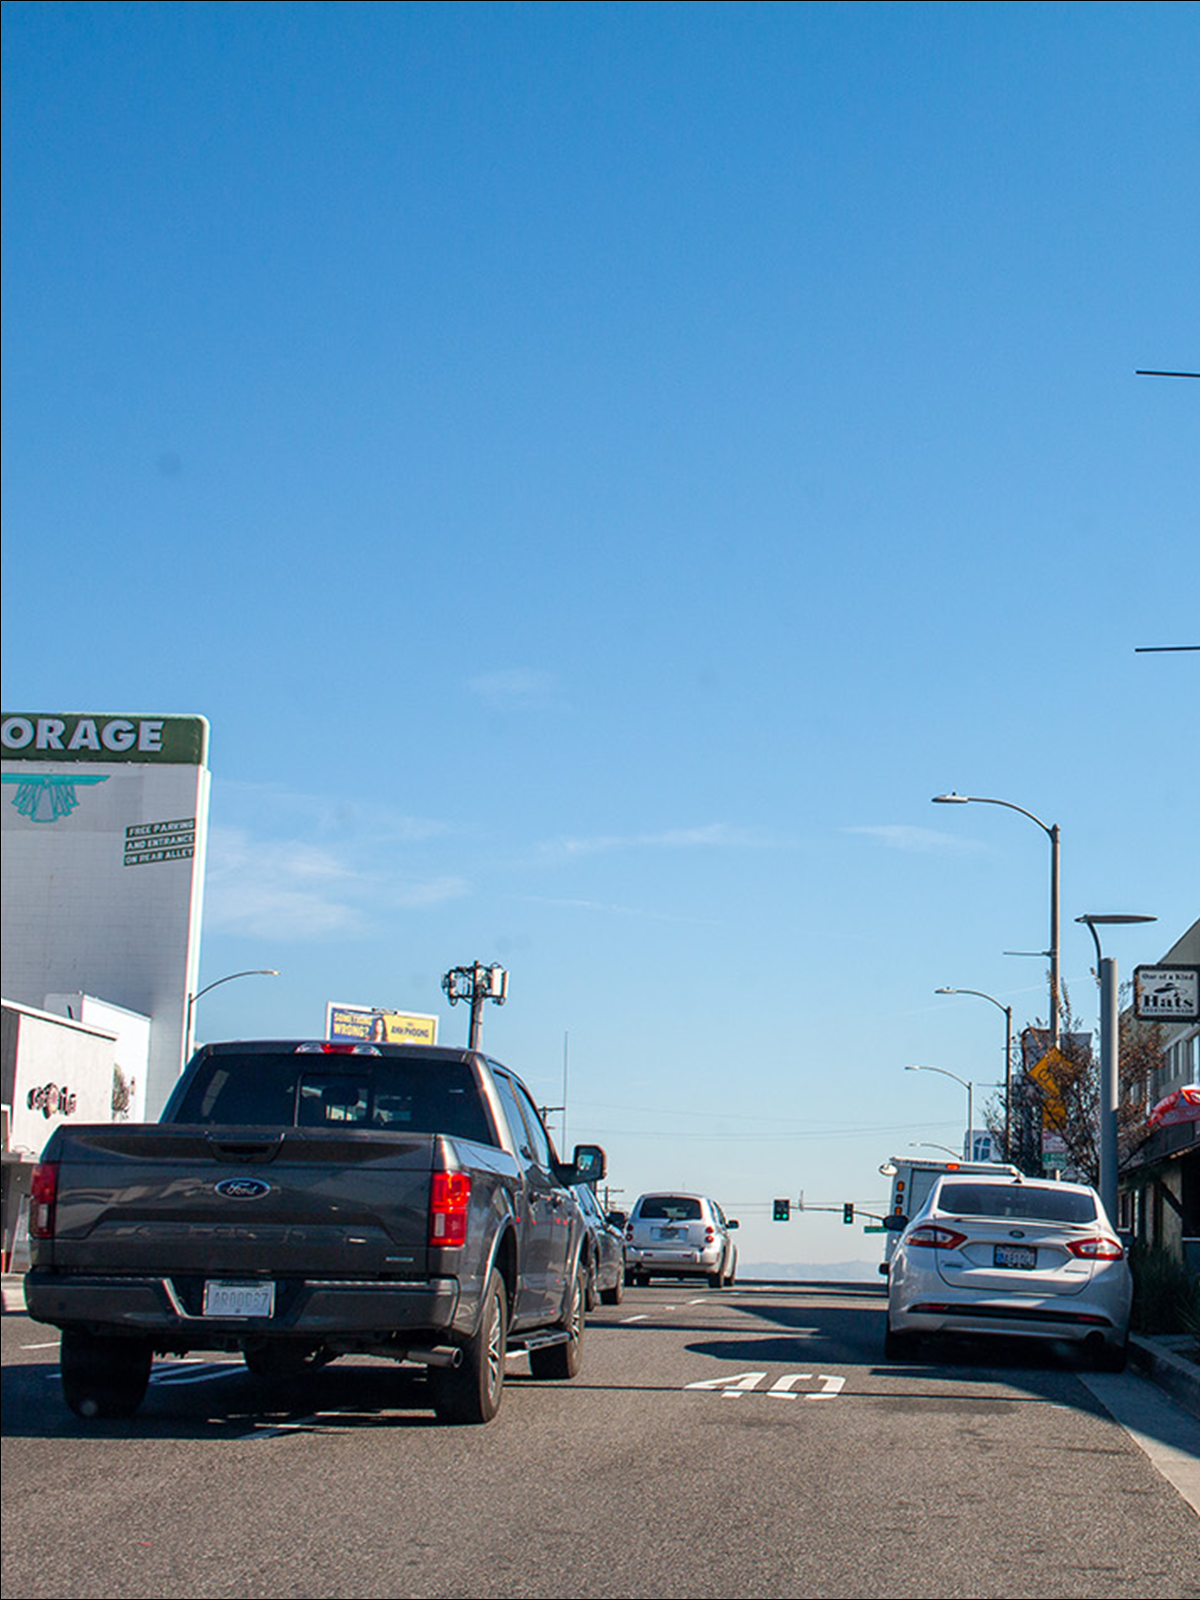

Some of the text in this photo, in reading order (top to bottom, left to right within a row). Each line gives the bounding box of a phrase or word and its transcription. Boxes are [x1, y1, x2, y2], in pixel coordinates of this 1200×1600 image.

[1, 717, 165, 751] ORAGE
[129, 820, 194, 837] FREE PARKING
[126, 834, 194, 851] AND ENTRANCE
[125, 848, 194, 865] ON REAR ALLEY
[1144, 995, 1194, 1007] Hats
[683, 1372, 846, 1400] 40
